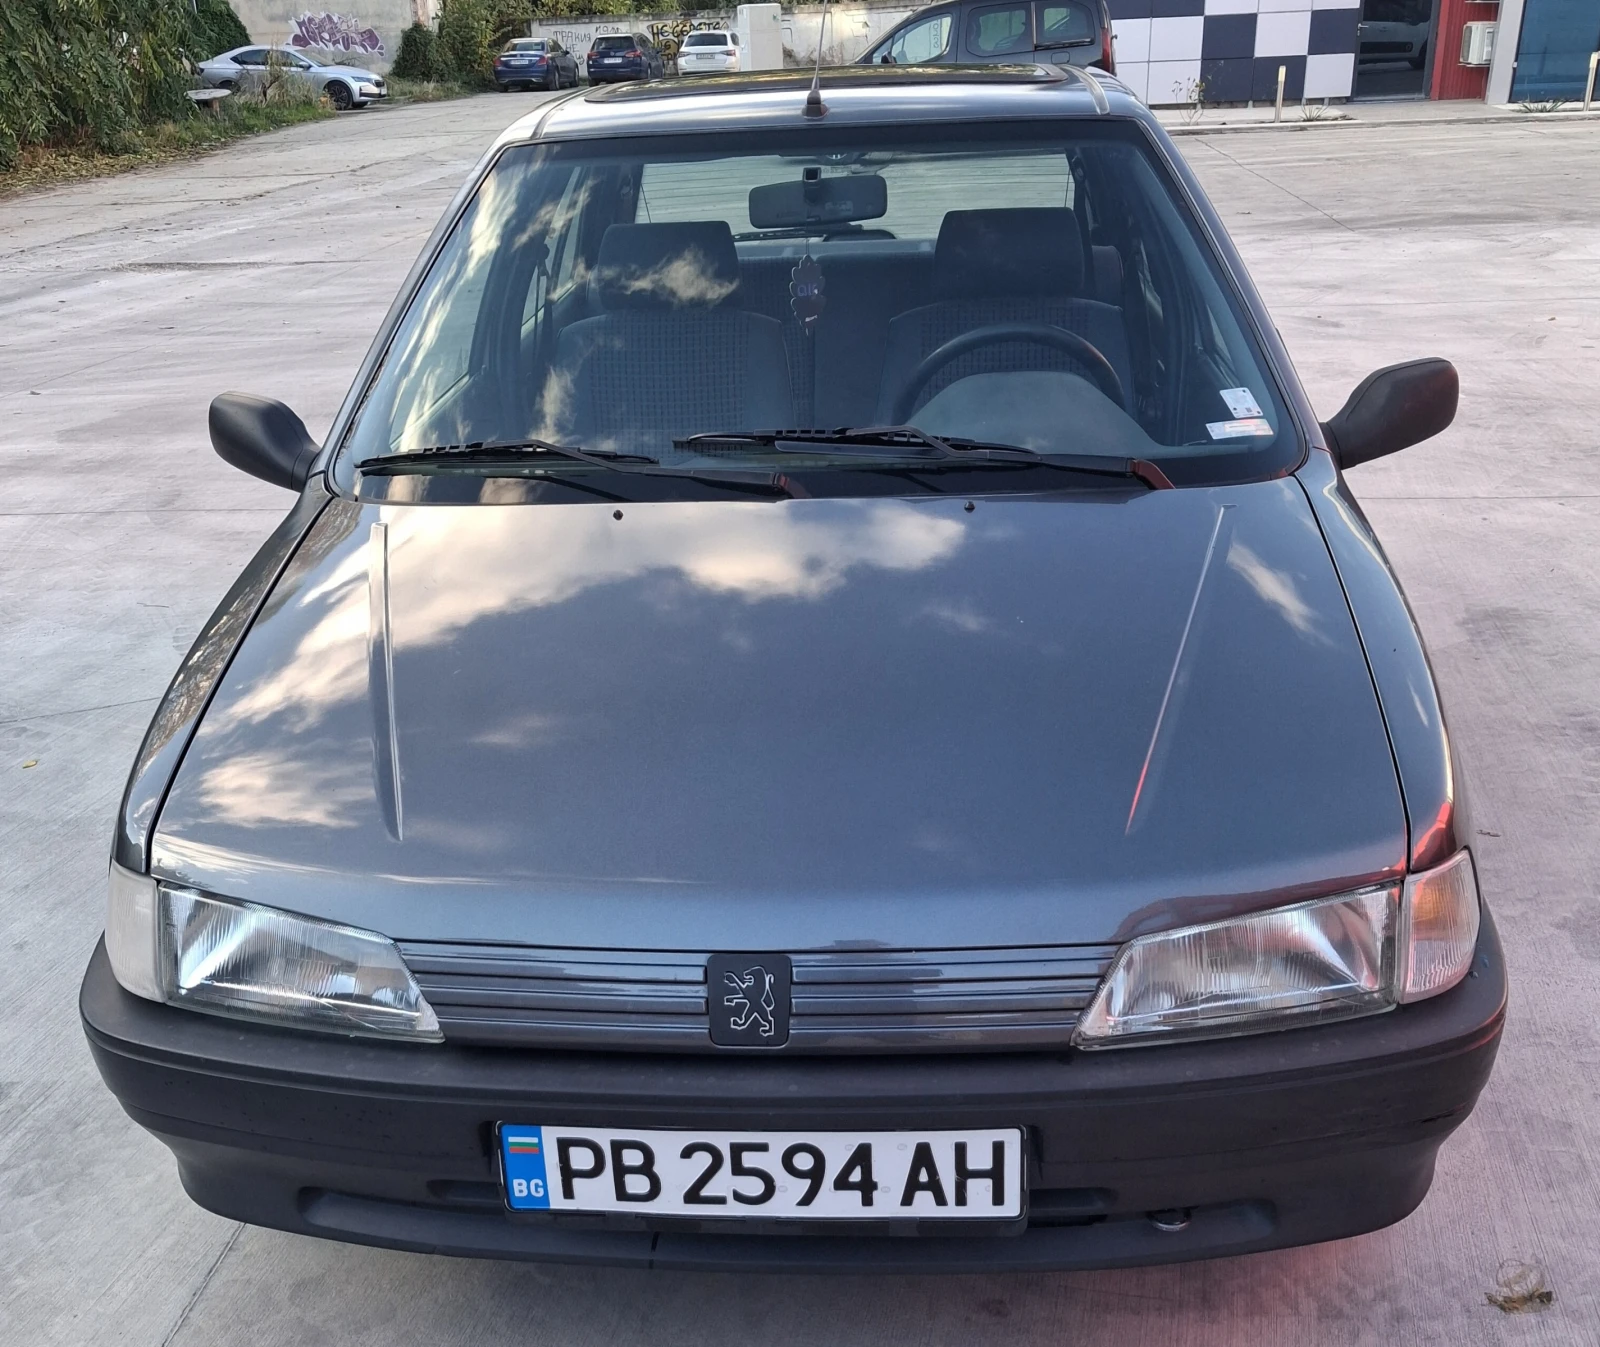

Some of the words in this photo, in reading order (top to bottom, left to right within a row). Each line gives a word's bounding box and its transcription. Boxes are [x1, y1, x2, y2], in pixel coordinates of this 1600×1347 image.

[553, 30, 592, 43] ТРАКИЯ
[556, 1136, 662, 1203] PB
[679, 1140, 879, 1207] 2594
[900, 1140, 1006, 1207] AH
[512, 1179, 545, 1198] BG
